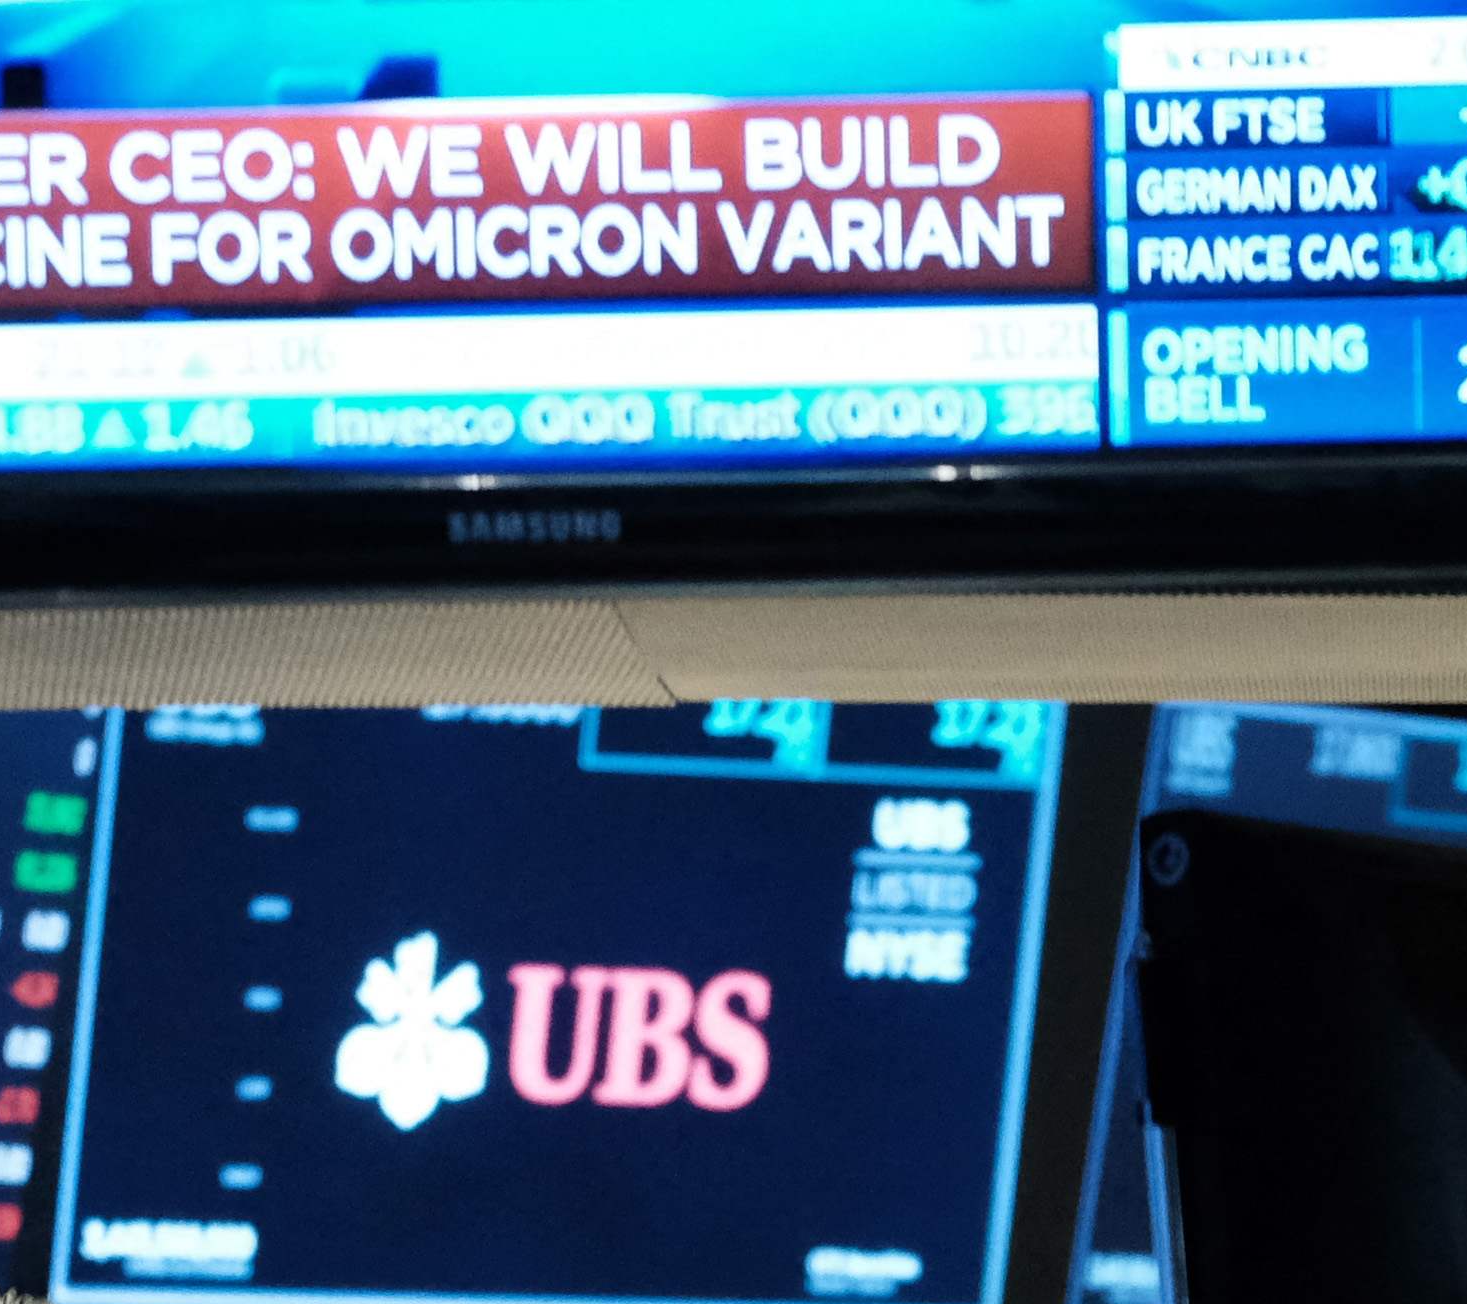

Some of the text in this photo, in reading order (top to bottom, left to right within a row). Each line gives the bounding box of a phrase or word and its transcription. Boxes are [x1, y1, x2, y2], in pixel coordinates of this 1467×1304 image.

[1192, 40, 1332, 72] CNBC
[1135, 98, 1203, 147] UK
[1212, 95, 1327, 146] FTSE
[108, 127, 314, 204] CEO:
[337, 124, 485, 198] WE
[504, 119, 723, 197] WILL
[743, 114, 1001, 192] BUILD
[1136, 164, 1292, 216] GERMAN
[1298, 162, 1378, 212] DAX
[150, 208, 312, 286] FOR
[330, 199, 700, 281] OMICRON
[716, 194, 1065, 275] VARIANT
[1137, 235, 1292, 285] FRANCE
[1297, 233, 1379, 281] CAC
[1141, 323, 1369, 378] OPENING
[311, 398, 517, 449] Invesco
[668, 392, 802, 441] Trust
[1144, 374, 1266, 425] BELL
[448, 511, 622, 543] SAMSUNG
[506, 963, 772, 1113] UBS
